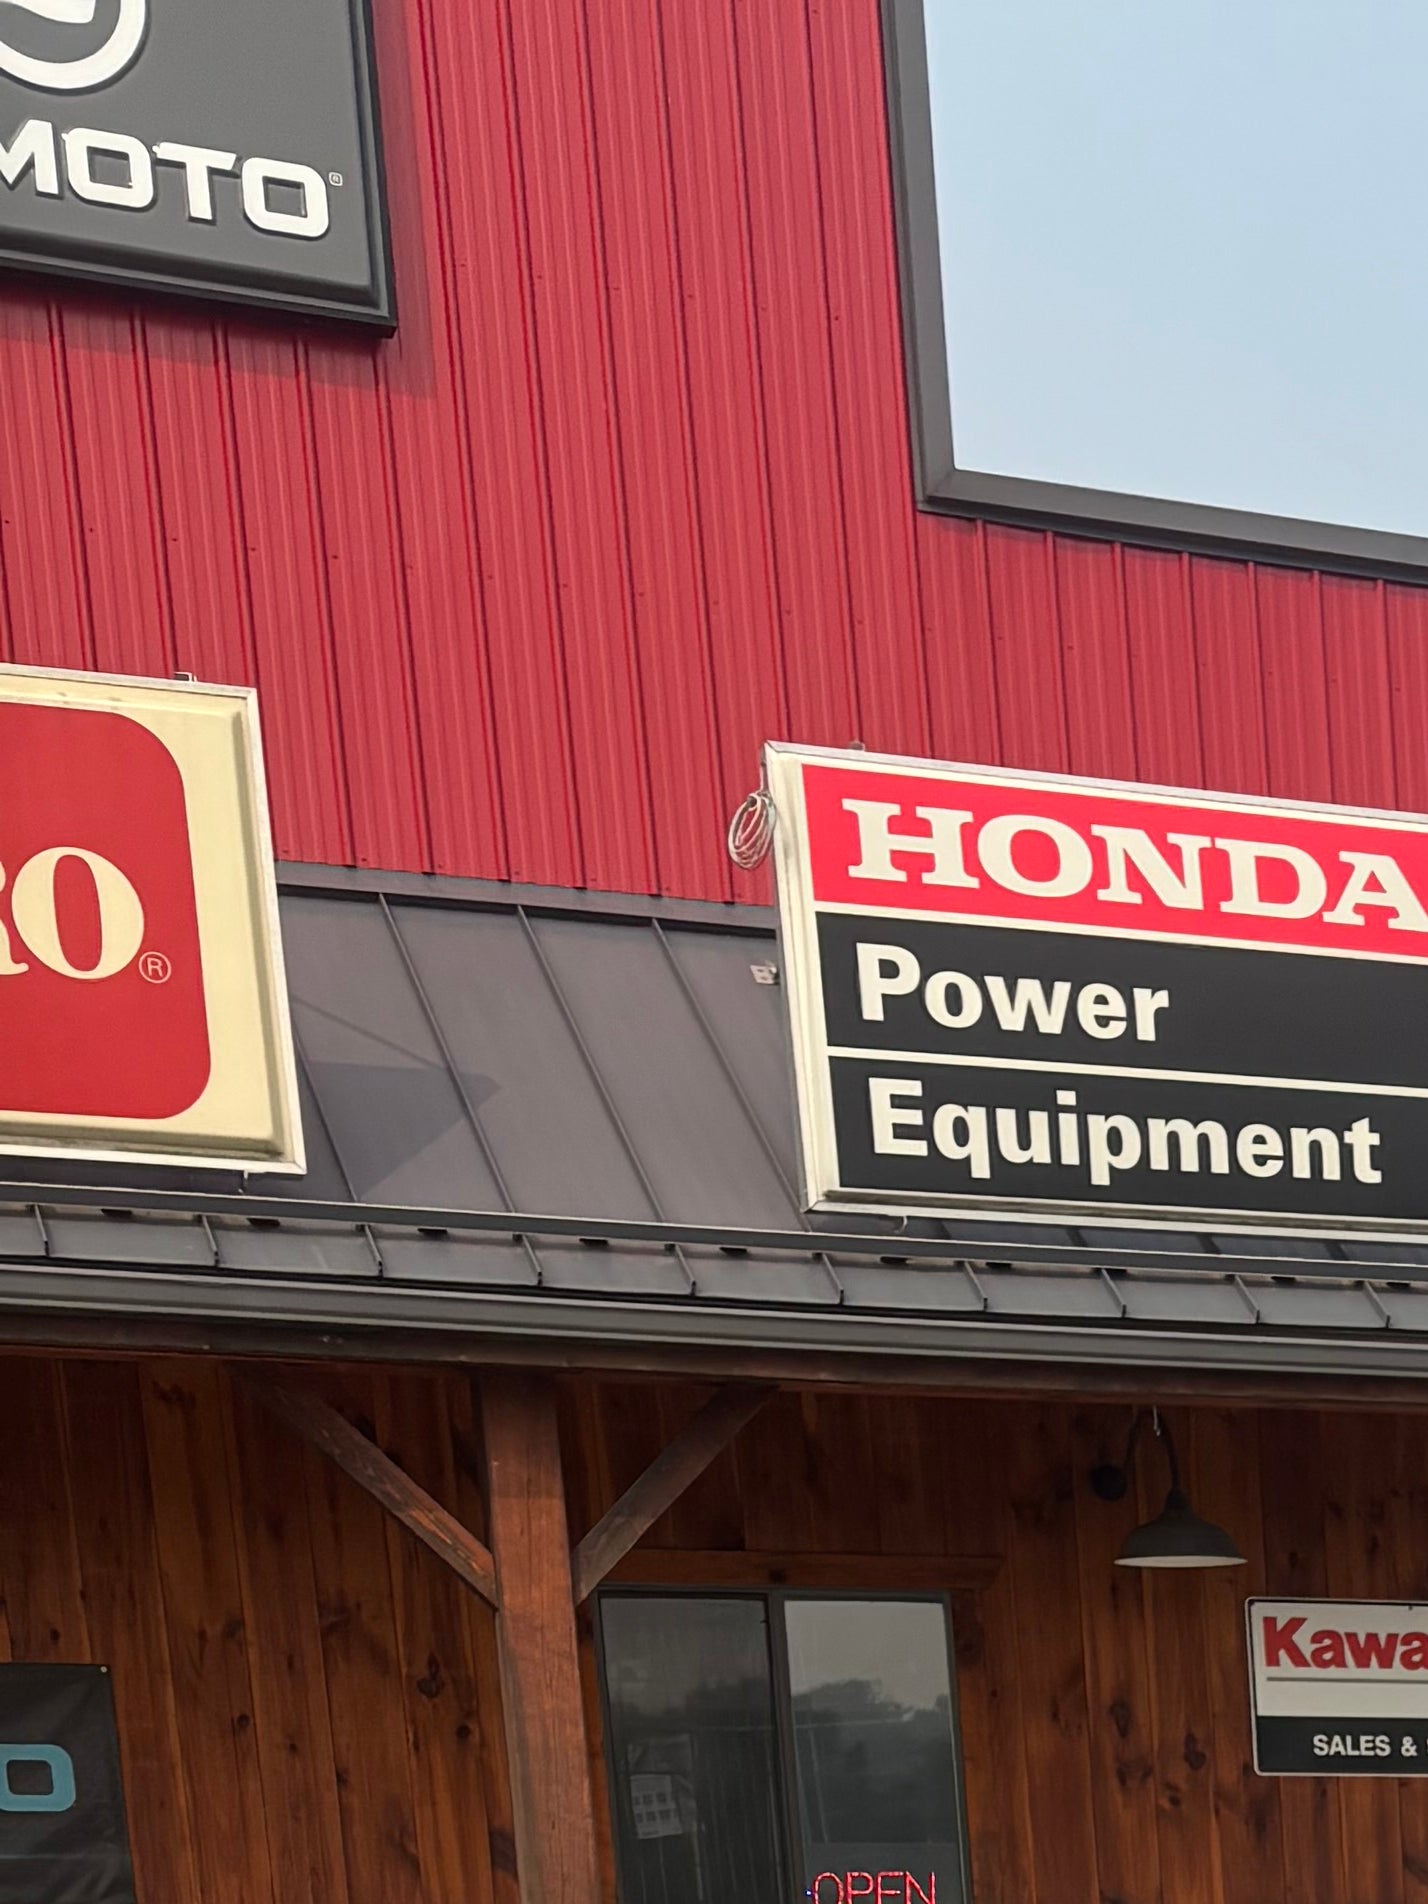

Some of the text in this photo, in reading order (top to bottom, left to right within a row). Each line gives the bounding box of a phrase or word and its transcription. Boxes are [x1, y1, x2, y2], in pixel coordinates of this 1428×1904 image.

[855, 941, 1170, 1042] Power
[868, 1078, 1383, 1186] Equipment
[1313, 1734, 1391, 1758] SALES
[1400, 1736, 1418, 1758] &
